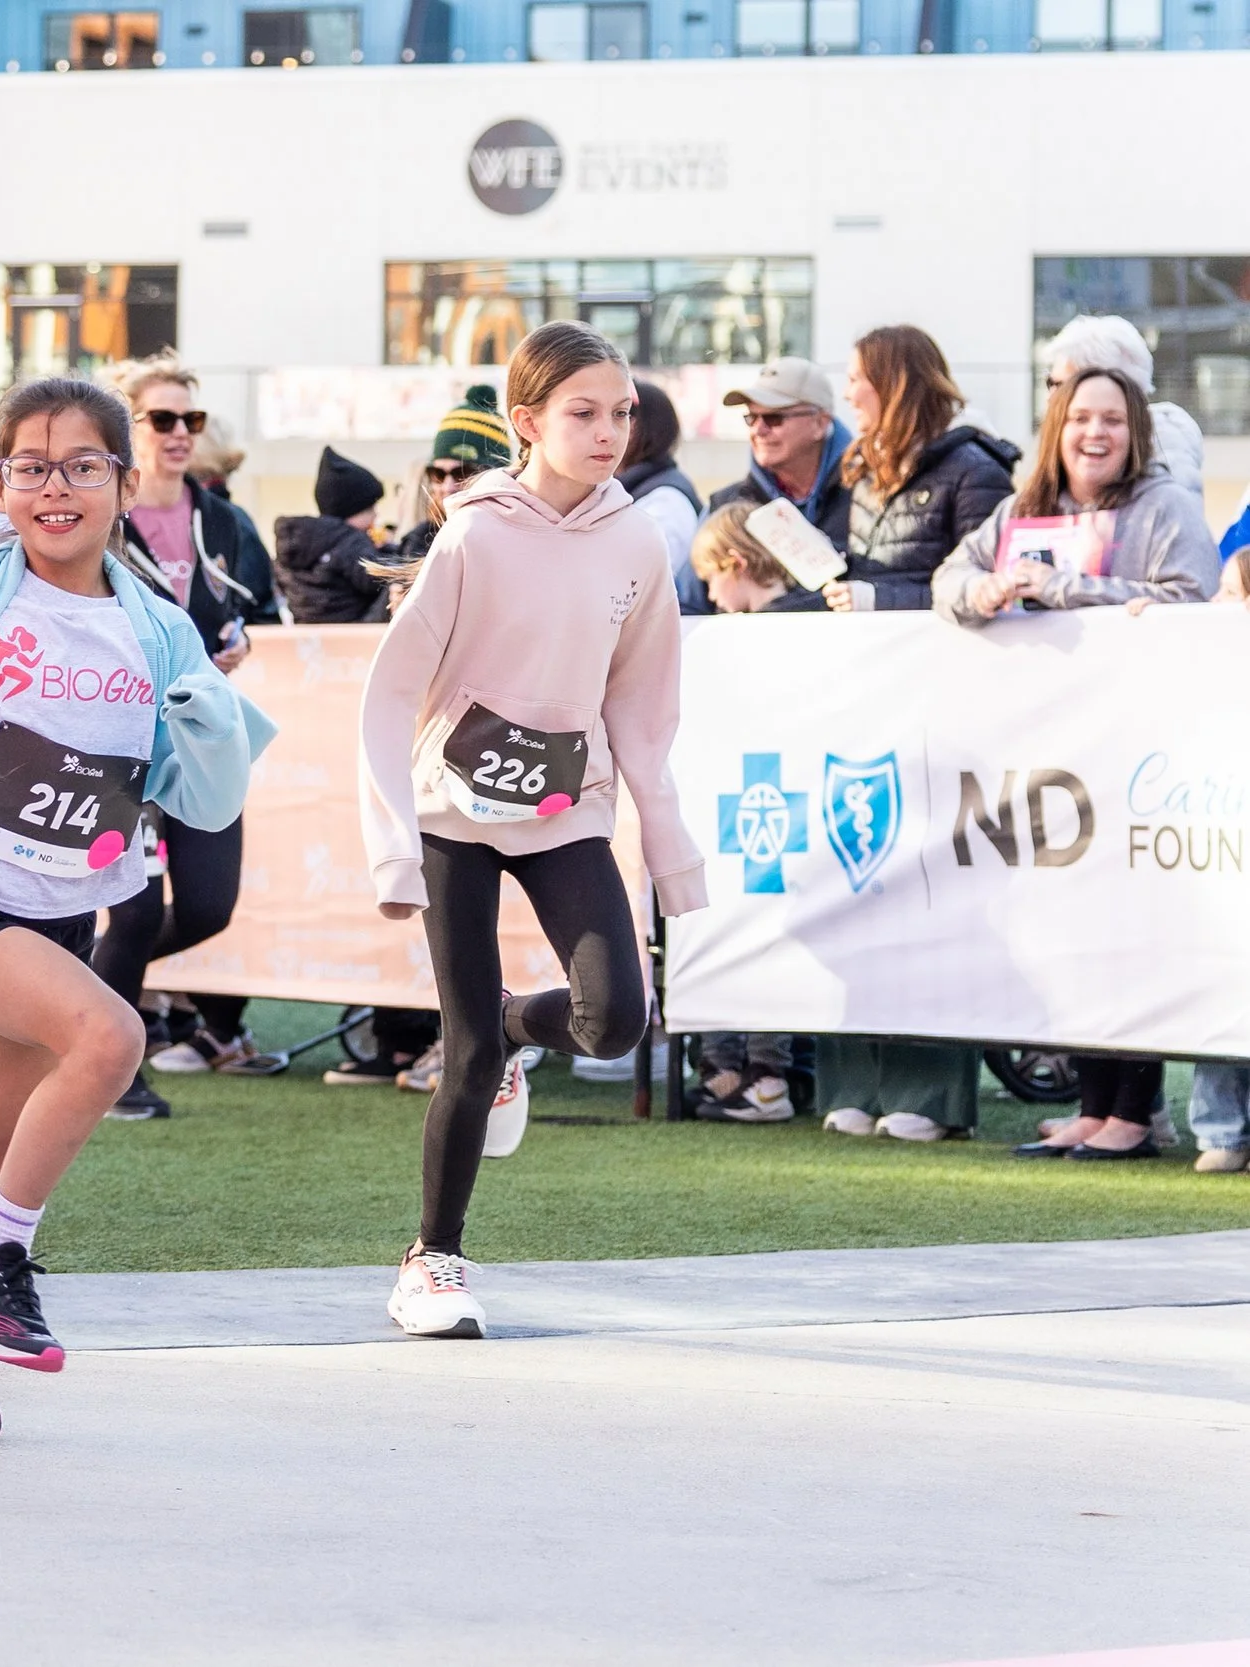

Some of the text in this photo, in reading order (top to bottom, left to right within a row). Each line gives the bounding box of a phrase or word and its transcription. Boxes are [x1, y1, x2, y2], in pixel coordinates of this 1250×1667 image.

[472, 750, 547, 795] 226
[18, 783, 100, 835] 214
[952, 768, 1095, 868] ND
[38, 854, 53, 863] ND
